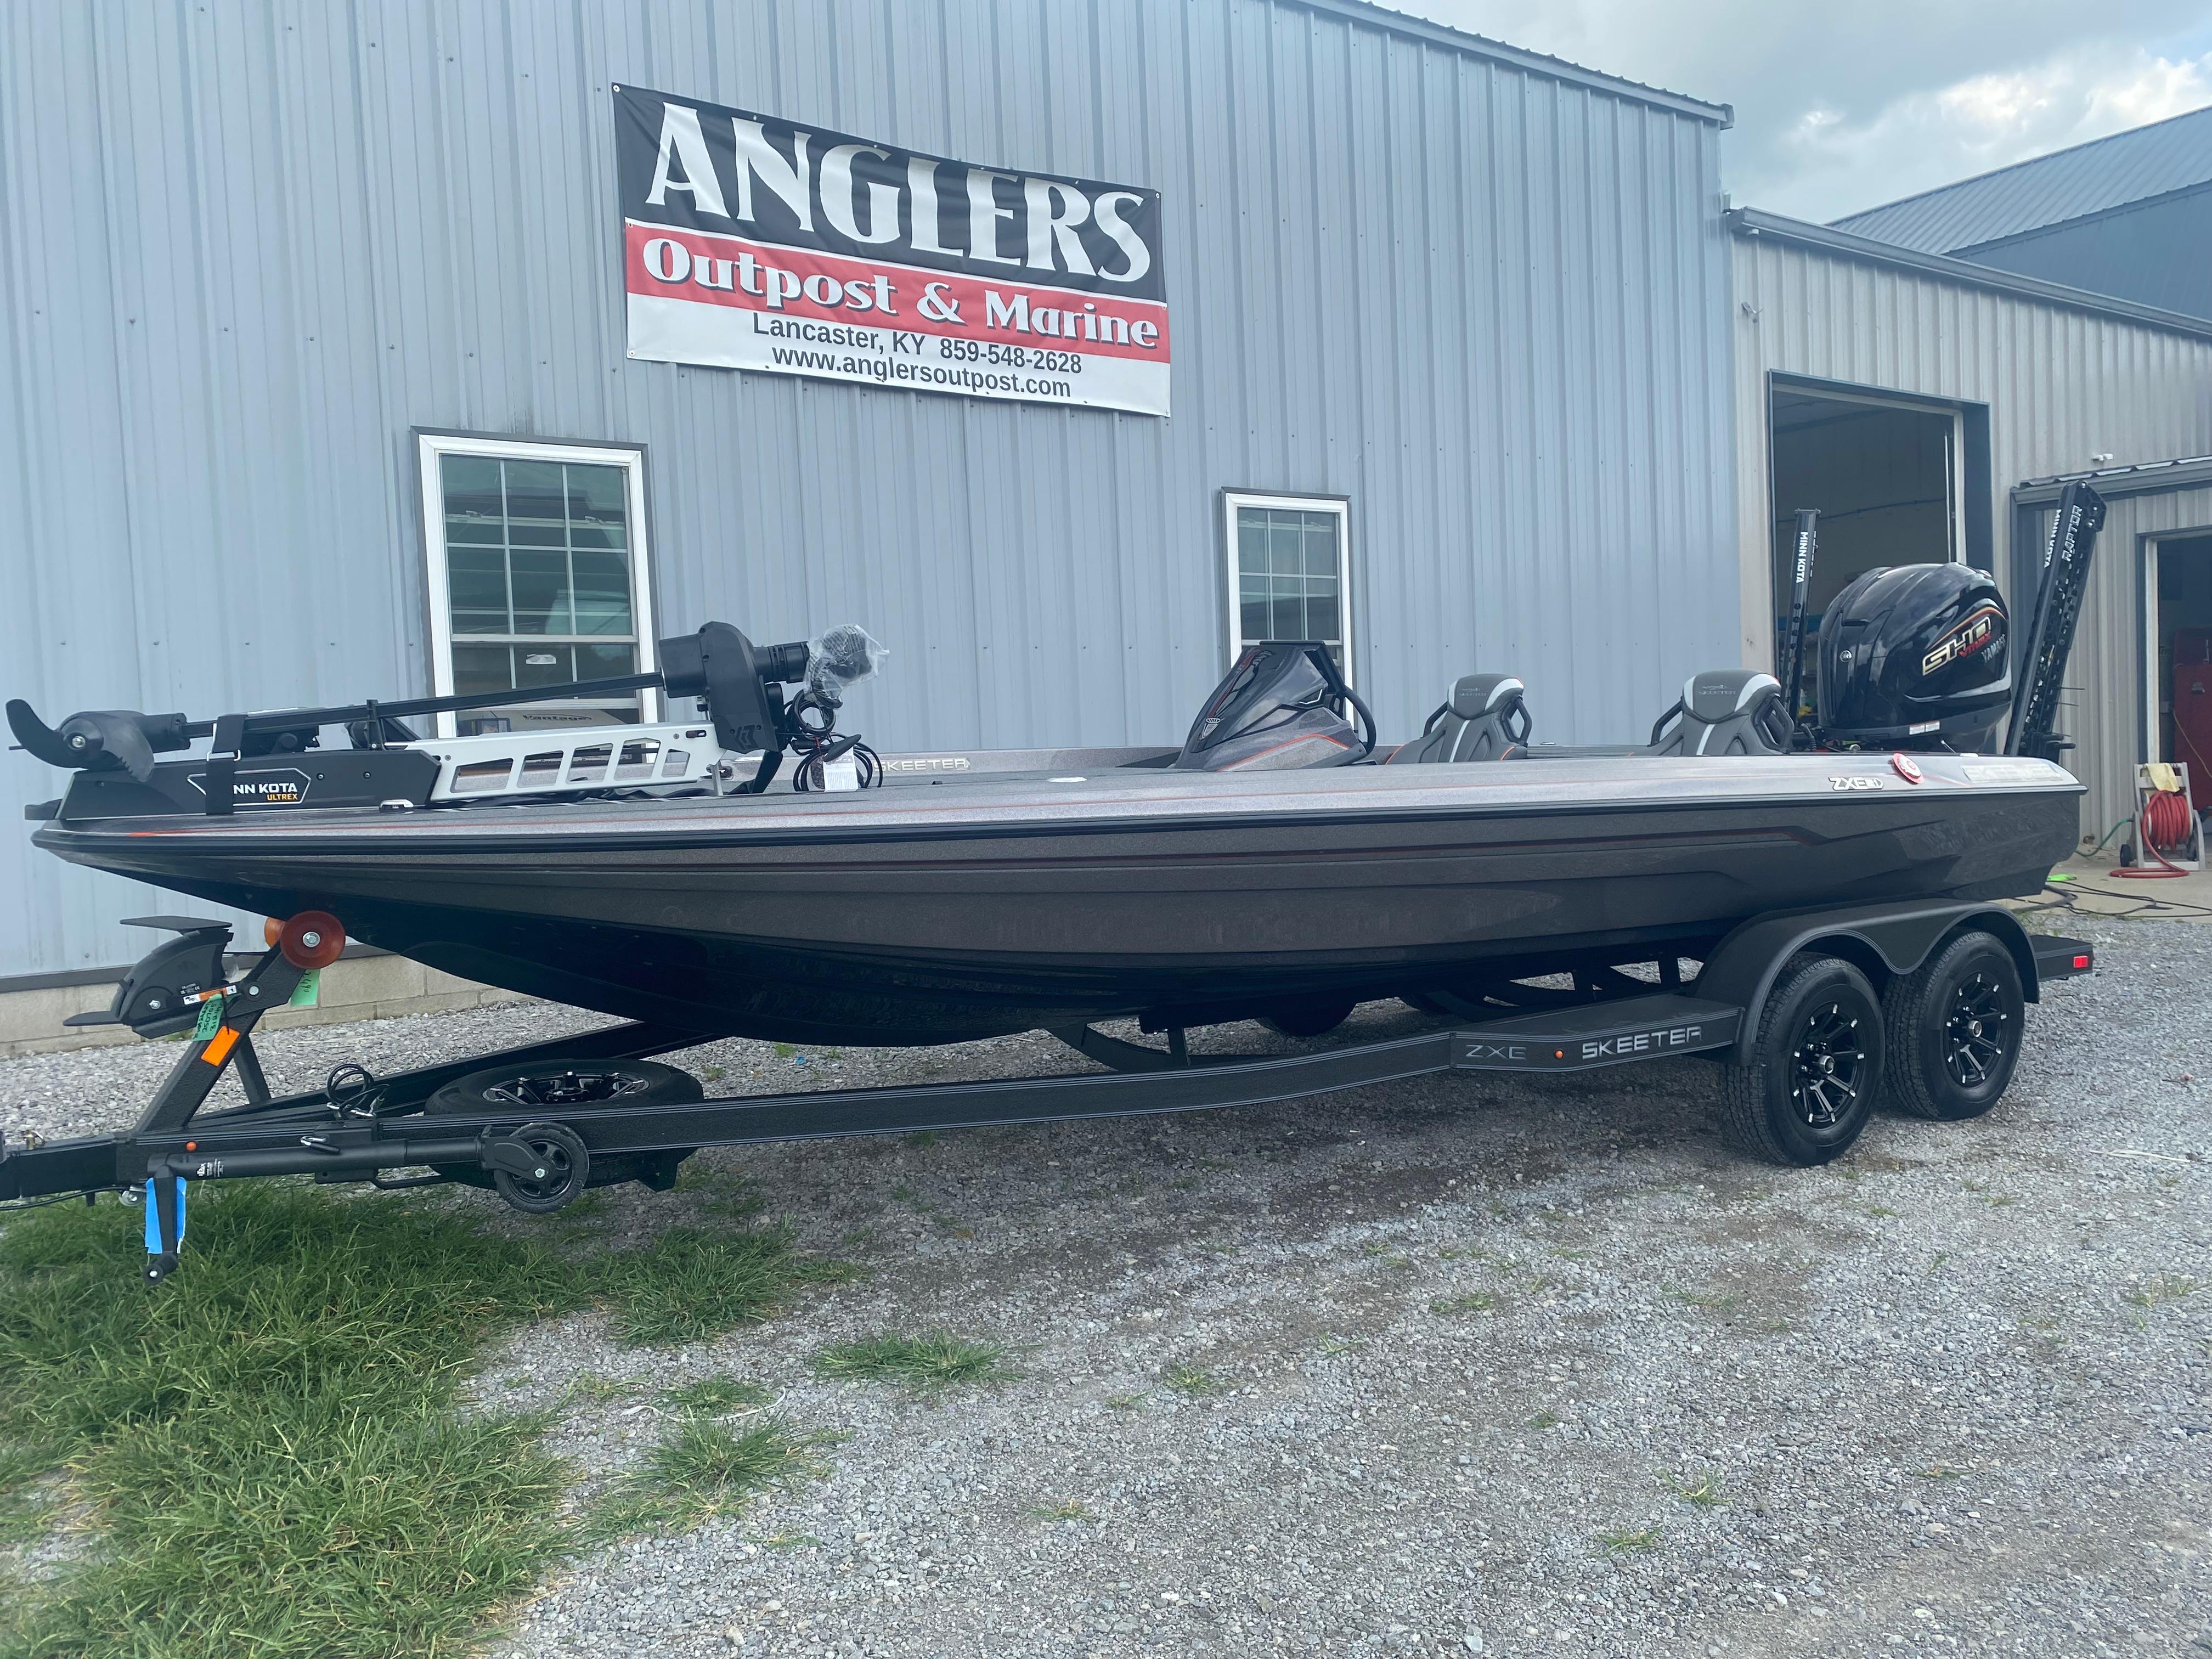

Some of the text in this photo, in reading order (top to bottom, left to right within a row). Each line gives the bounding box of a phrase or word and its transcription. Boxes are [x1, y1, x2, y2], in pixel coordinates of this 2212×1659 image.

[645, 101, 1150, 282] ANGLERS
[643, 238, 1160, 349] Outpost & Marine
[753, 312, 1082, 374] Lancaster, KY 859-548-2628
[771, 347, 1071, 397] www.anglersoutpost.com
[1796, 532, 1808, 583] MINN KOTA
[2062, 505, 2083, 562] RAPTOR
[1922, 616, 1991, 676] SHO
[233, 783, 298, 794] NN KOTA
[873, 758, 967, 772] SKEETER
[1582, 1026, 1702, 1060] SKEETER
